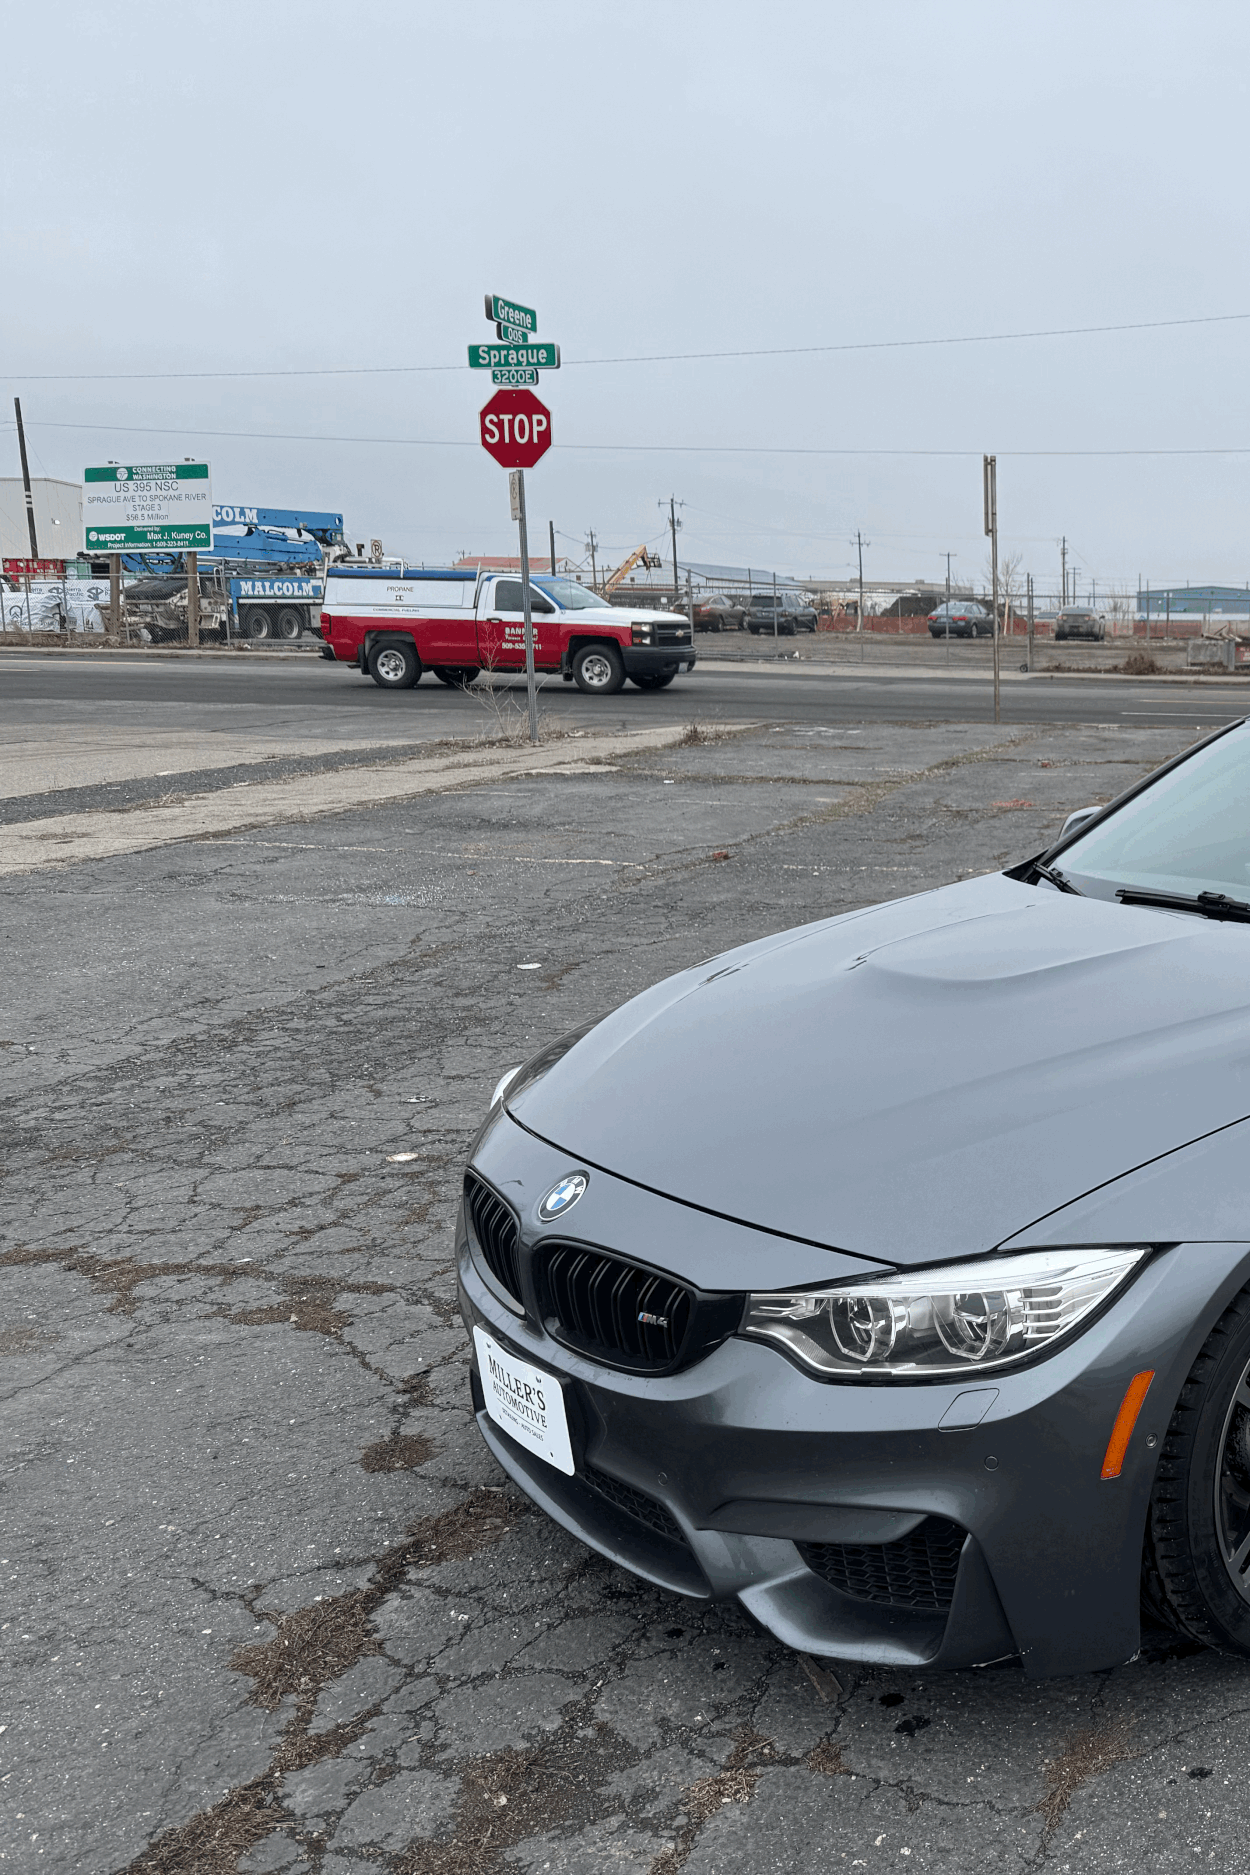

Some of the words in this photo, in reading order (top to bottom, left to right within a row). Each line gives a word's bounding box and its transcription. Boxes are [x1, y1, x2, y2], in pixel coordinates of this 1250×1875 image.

[497, 300, 533, 329] Greene
[507, 327, 523, 343] 00S
[478, 346, 548, 367] Sprague
[493, 370, 533, 384] 3200E
[484, 413, 548, 444] STOP
[132, 465, 176, 473] CONNECTING
[132, 472, 177, 480] WASHINGTON
[114, 482, 130, 493] US
[132, 481, 152, 492] 395
[155, 480, 179, 492] NSC
[87, 495, 121, 504] SPRAGUE
[122, 495, 136, 503] AVE
[138, 495, 148, 503] TO
[149, 493, 183, 502] SPOKANE
[185, 493, 207, 501] RIVER
[132, 504, 155, 512] STAGE
[157, 503, 162, 511] 3
[147, 513, 169, 521] Million
[98, 533, 126, 541] WSDOT
[147, 532, 162, 540] Max
[171, 531, 194, 541] Kuney
[195, 530, 208, 539] Co.
[240, 581, 314, 596] MALCOLM
[504, 627, 538, 635] BANNR
[487, 1354, 546, 1411] MILLER'S
[492, 1380, 548, 1428] AUTOMOTIVE
